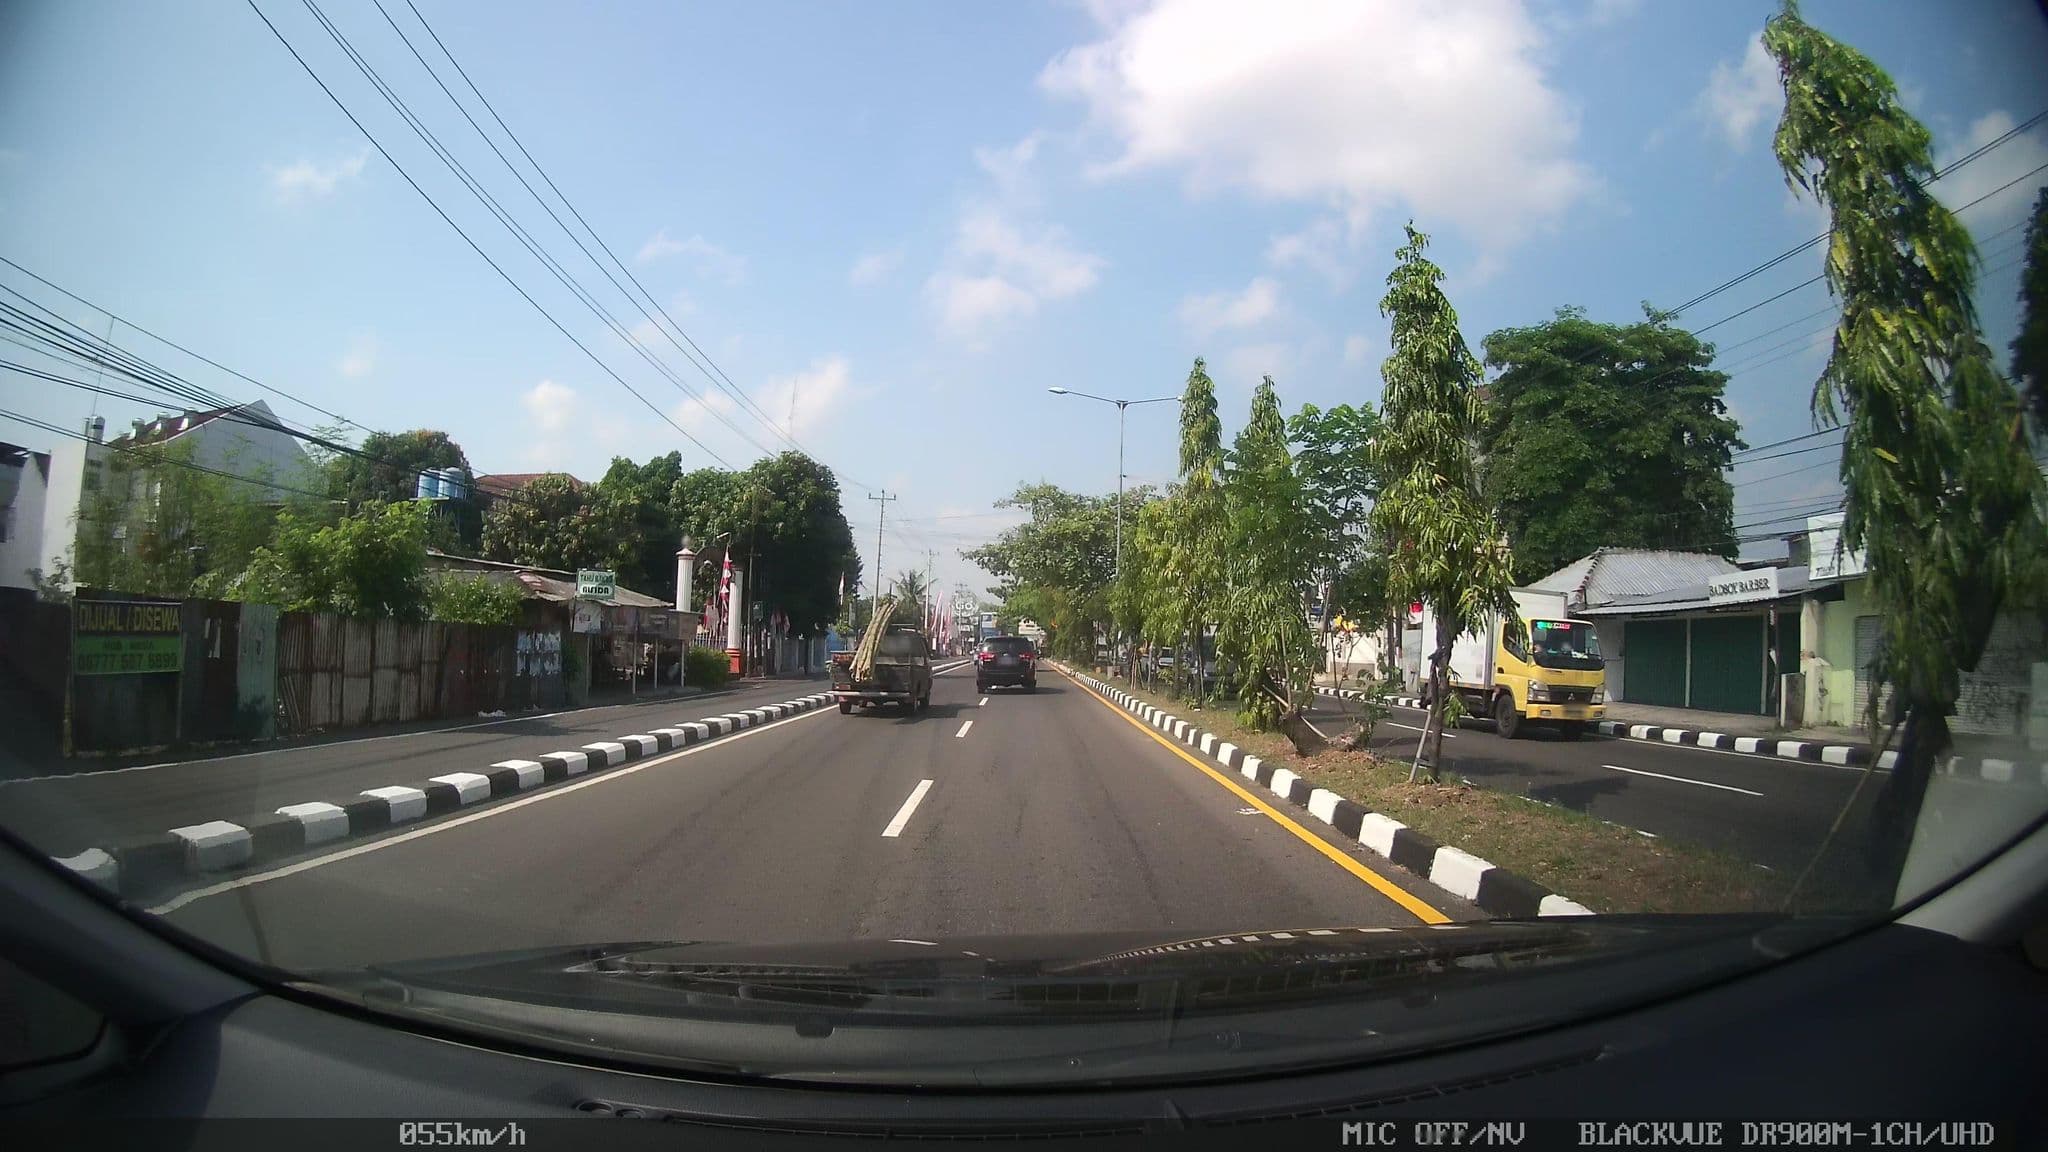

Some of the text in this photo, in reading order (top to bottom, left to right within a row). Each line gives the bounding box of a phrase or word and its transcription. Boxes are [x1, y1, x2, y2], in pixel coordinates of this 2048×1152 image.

[1739, 577, 1770, 593] BARBER
[79, 604, 123, 630] DIJUAL
[134, 606, 180, 632] DISEWA
